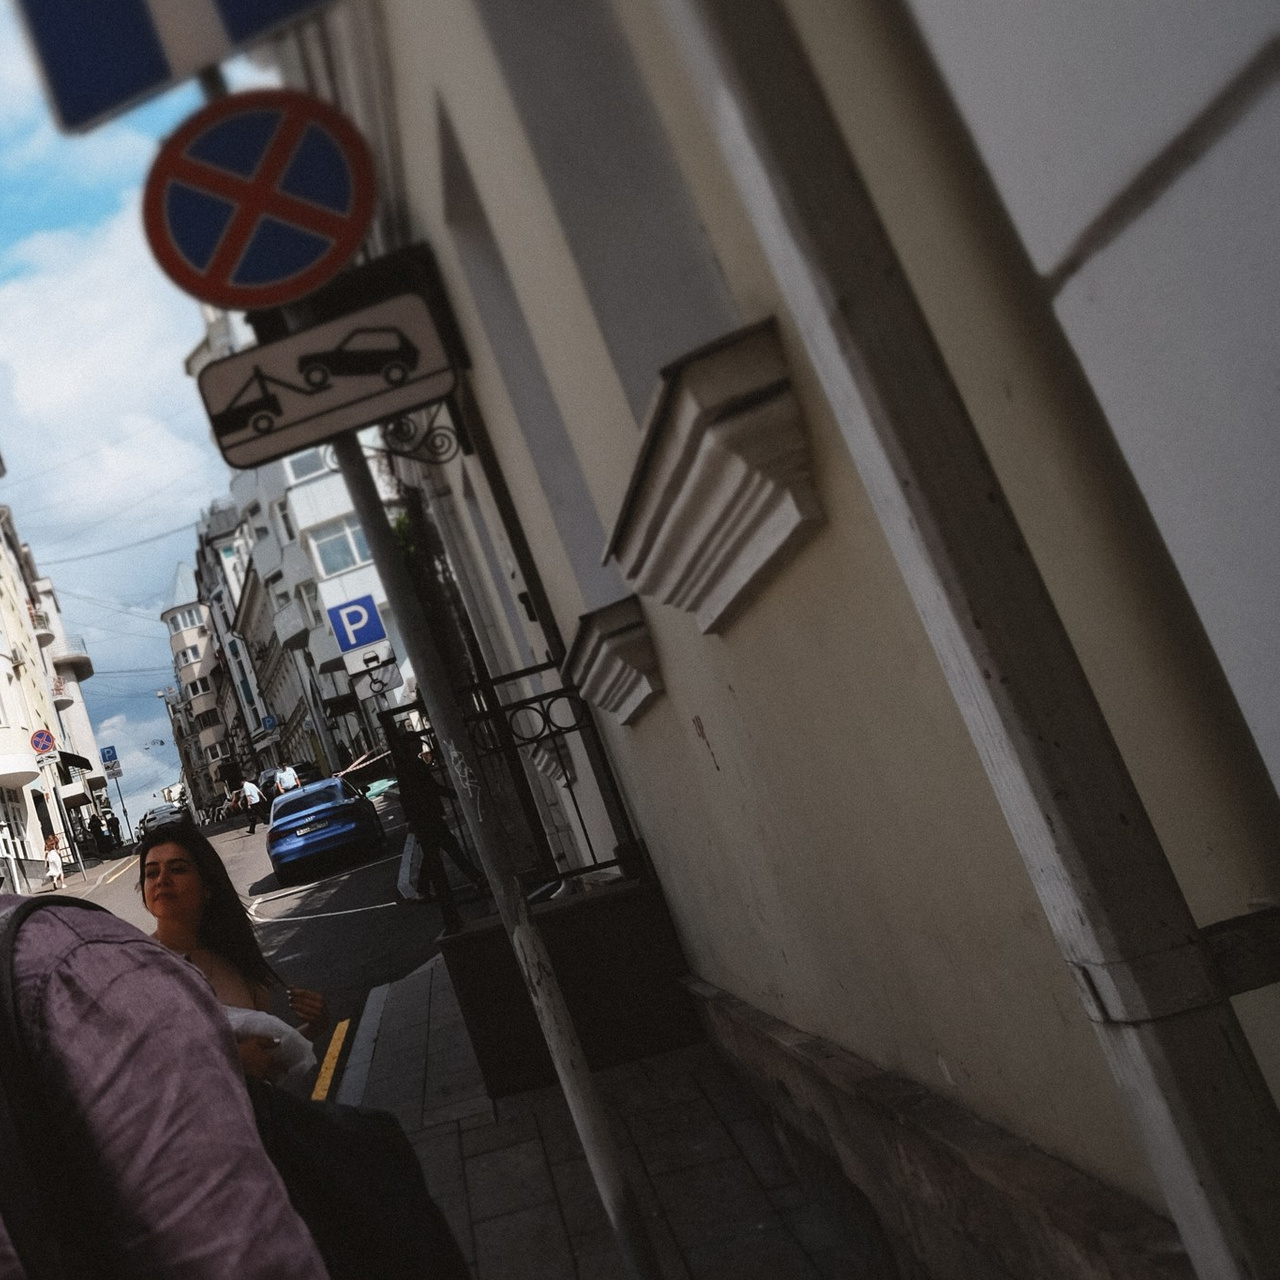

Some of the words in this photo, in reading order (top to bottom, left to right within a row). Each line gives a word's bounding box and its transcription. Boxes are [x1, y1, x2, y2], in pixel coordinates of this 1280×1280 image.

[339, 605, 369, 645] P
[265, 717, 273, 729] P
[104, 748, 113, 761] P
